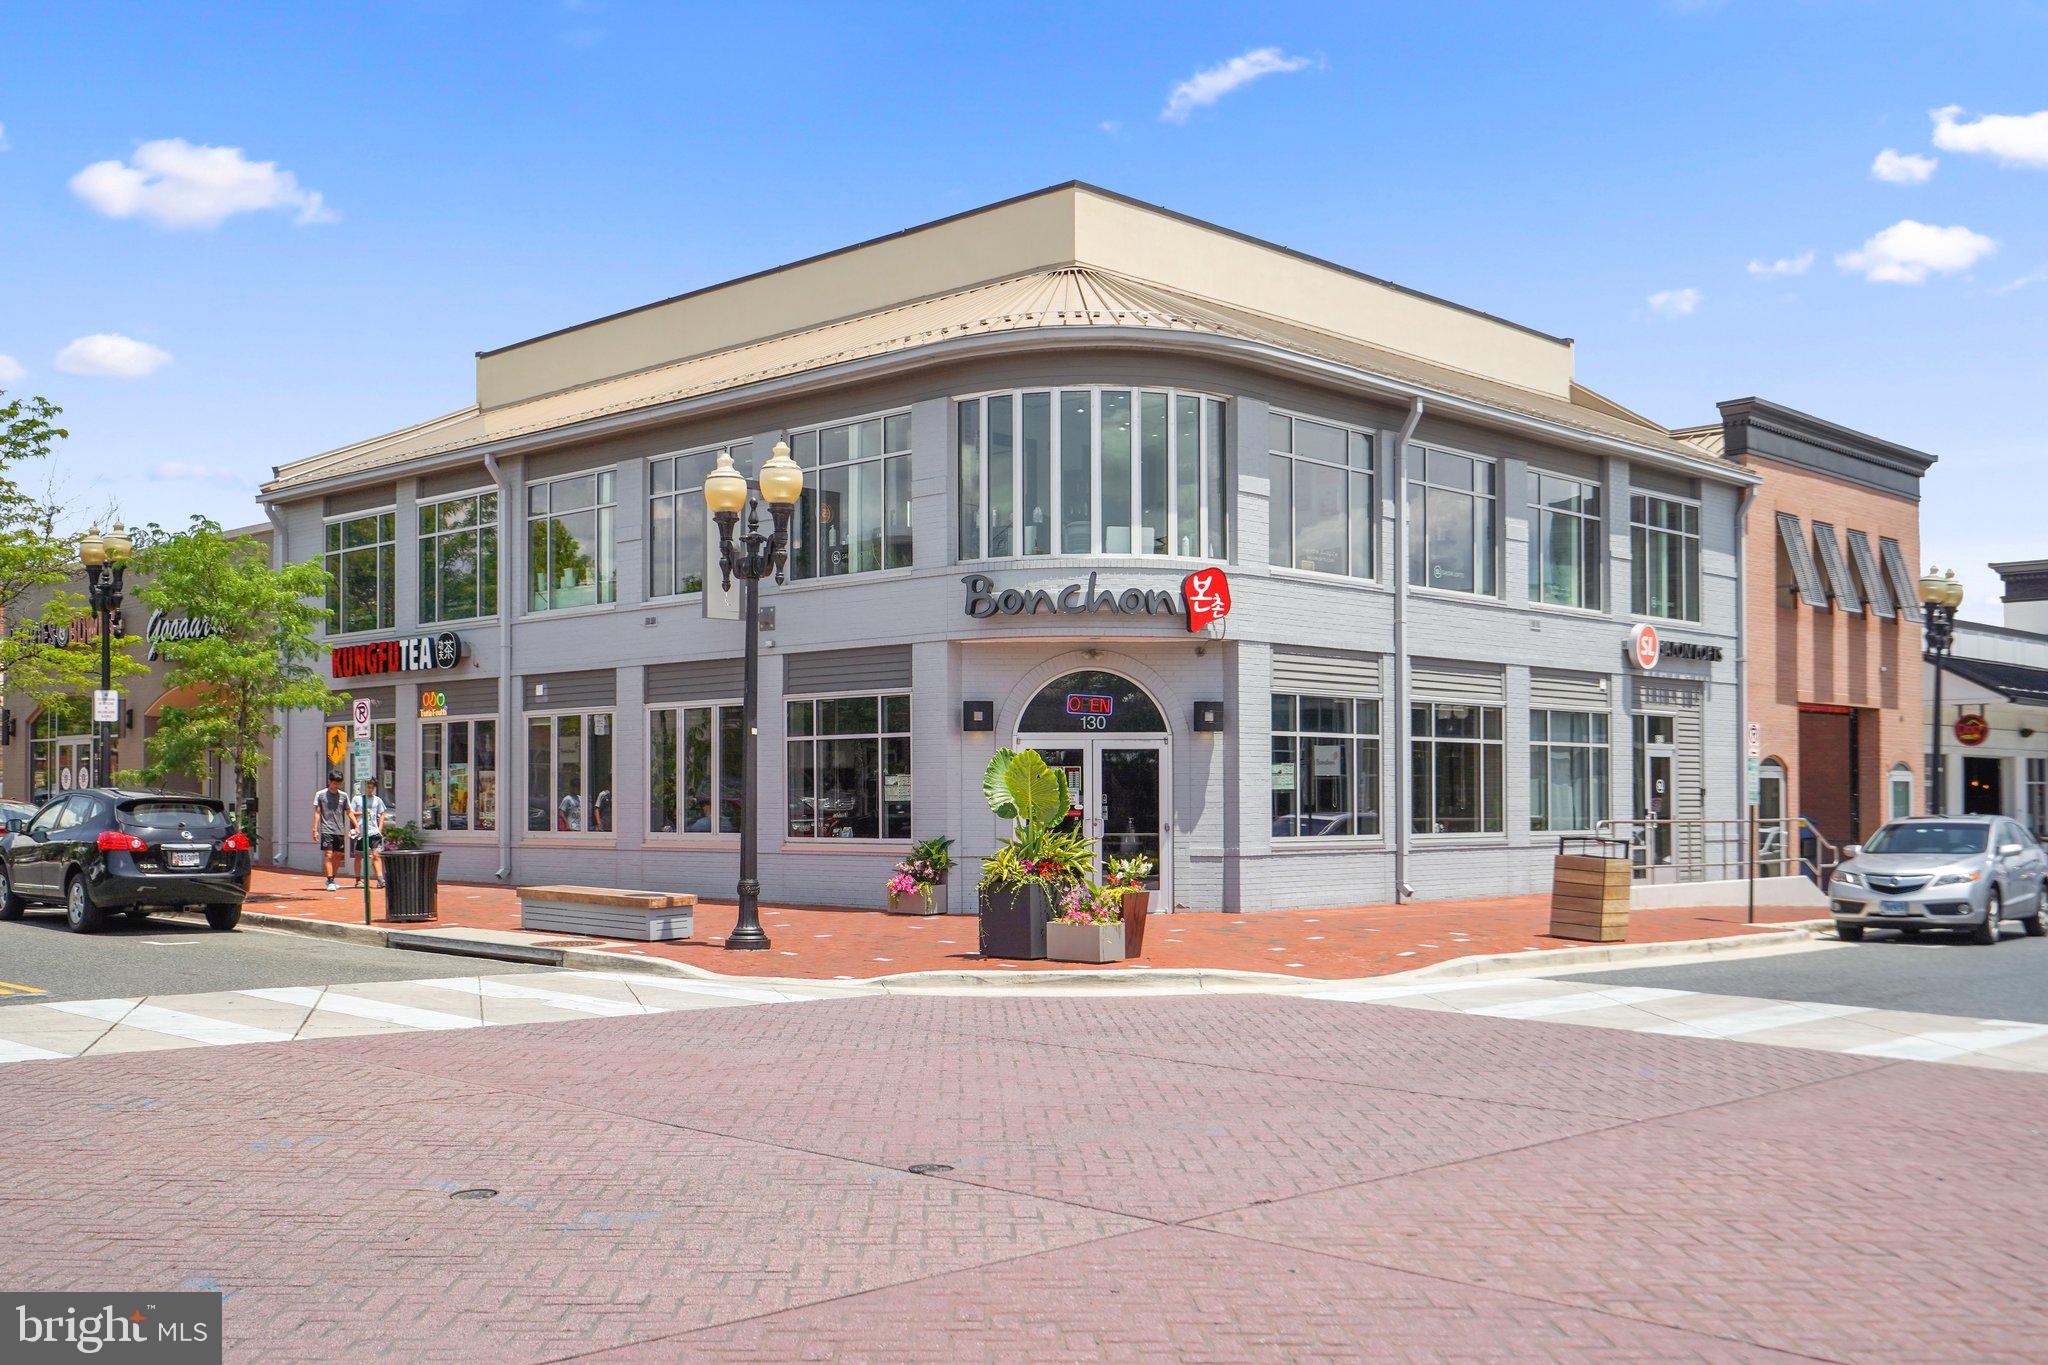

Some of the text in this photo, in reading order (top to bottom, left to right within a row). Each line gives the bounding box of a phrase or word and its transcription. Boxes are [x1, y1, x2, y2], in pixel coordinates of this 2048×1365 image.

[961, 571, 1177, 618] Bonchon
[1190, 575, 1225, 618] 본촌
[399, 637, 434, 671] TEA
[1641, 636, 1656, 656] SL
[1081, 716, 1107, 730] 130
